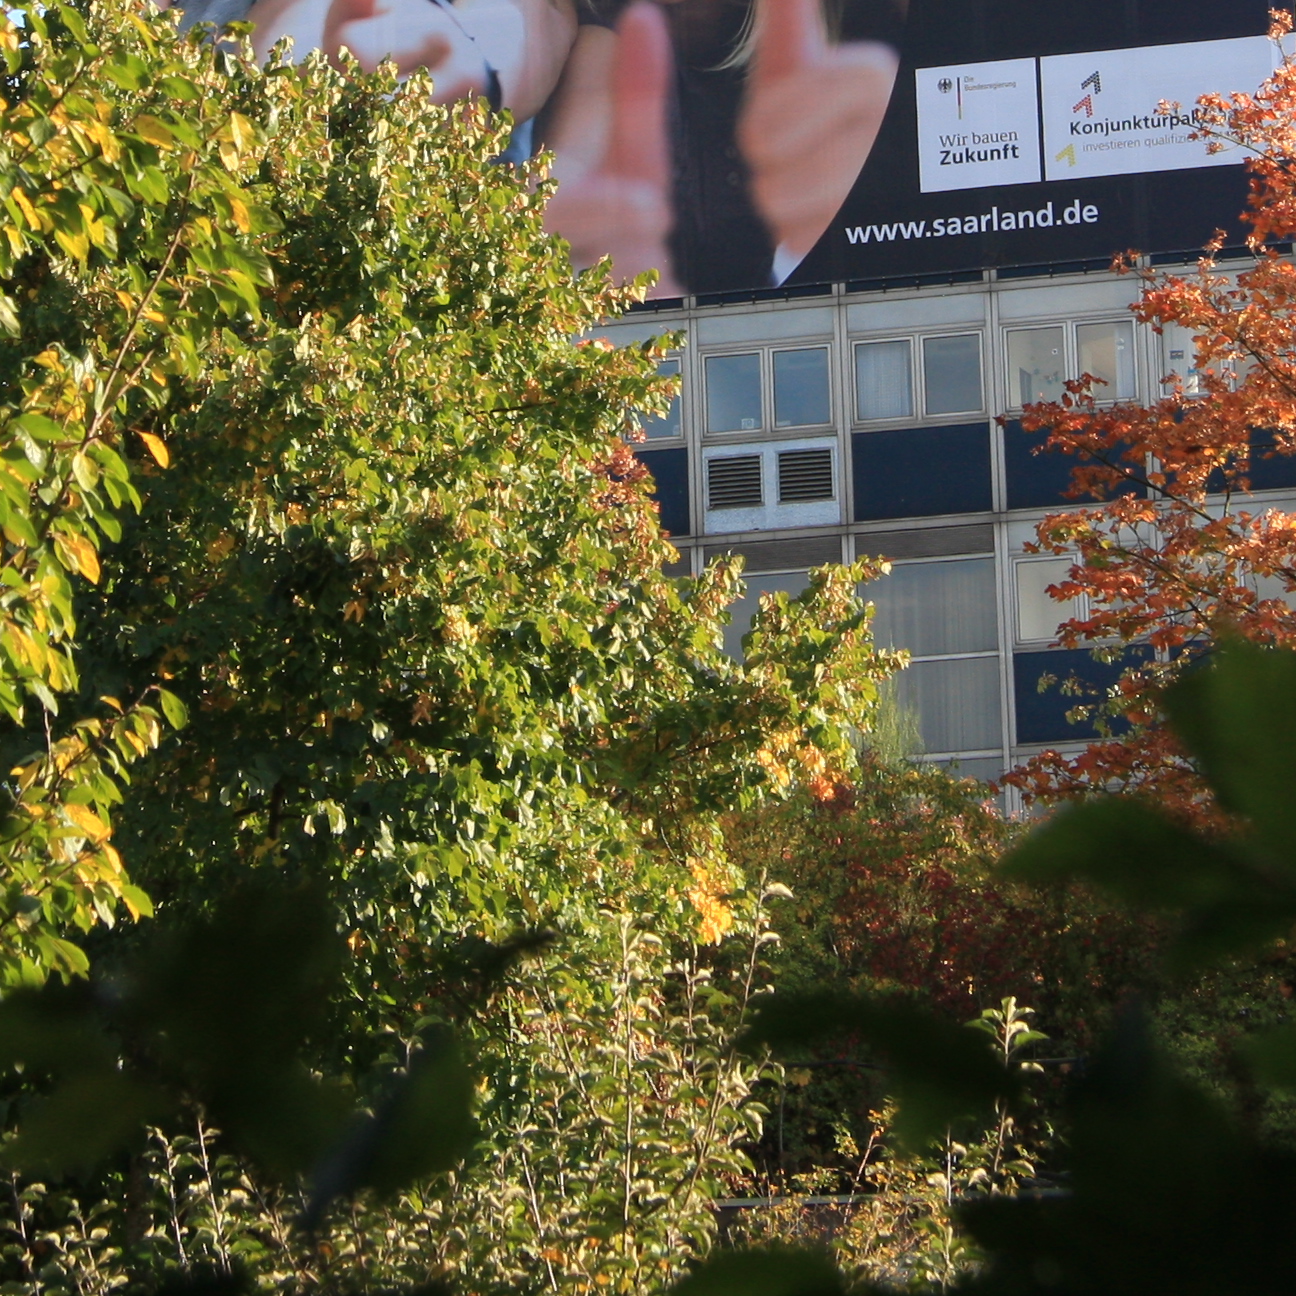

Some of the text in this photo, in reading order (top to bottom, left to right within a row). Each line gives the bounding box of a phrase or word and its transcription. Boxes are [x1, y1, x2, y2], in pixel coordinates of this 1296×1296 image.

[939, 130, 1018, 148] Wir bauen
[1082, 137, 1141, 152] investieren
[939, 144, 1020, 166] Zukunft
[845, 199, 1099, 245] www.saarland.de
